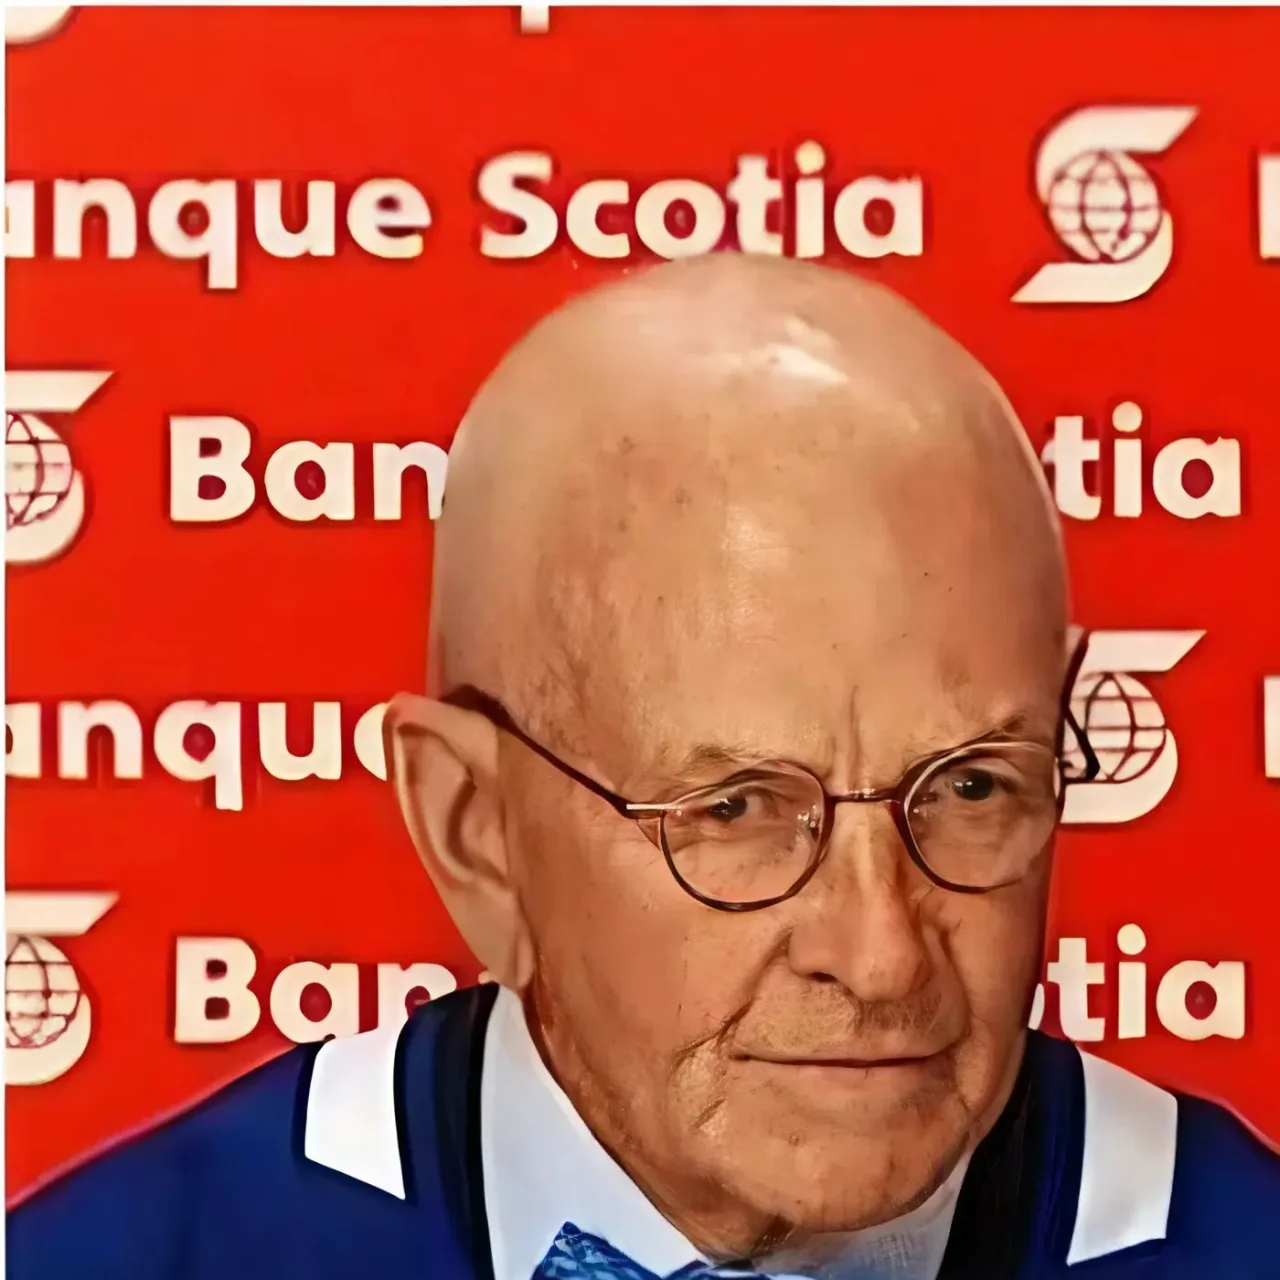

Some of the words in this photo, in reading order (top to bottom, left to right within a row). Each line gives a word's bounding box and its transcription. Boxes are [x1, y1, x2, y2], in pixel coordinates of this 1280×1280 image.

[478, 140, 923, 259] Scotia
[170, 415, 450, 521] Ban
[1029, 923, 1245, 1042] tia
